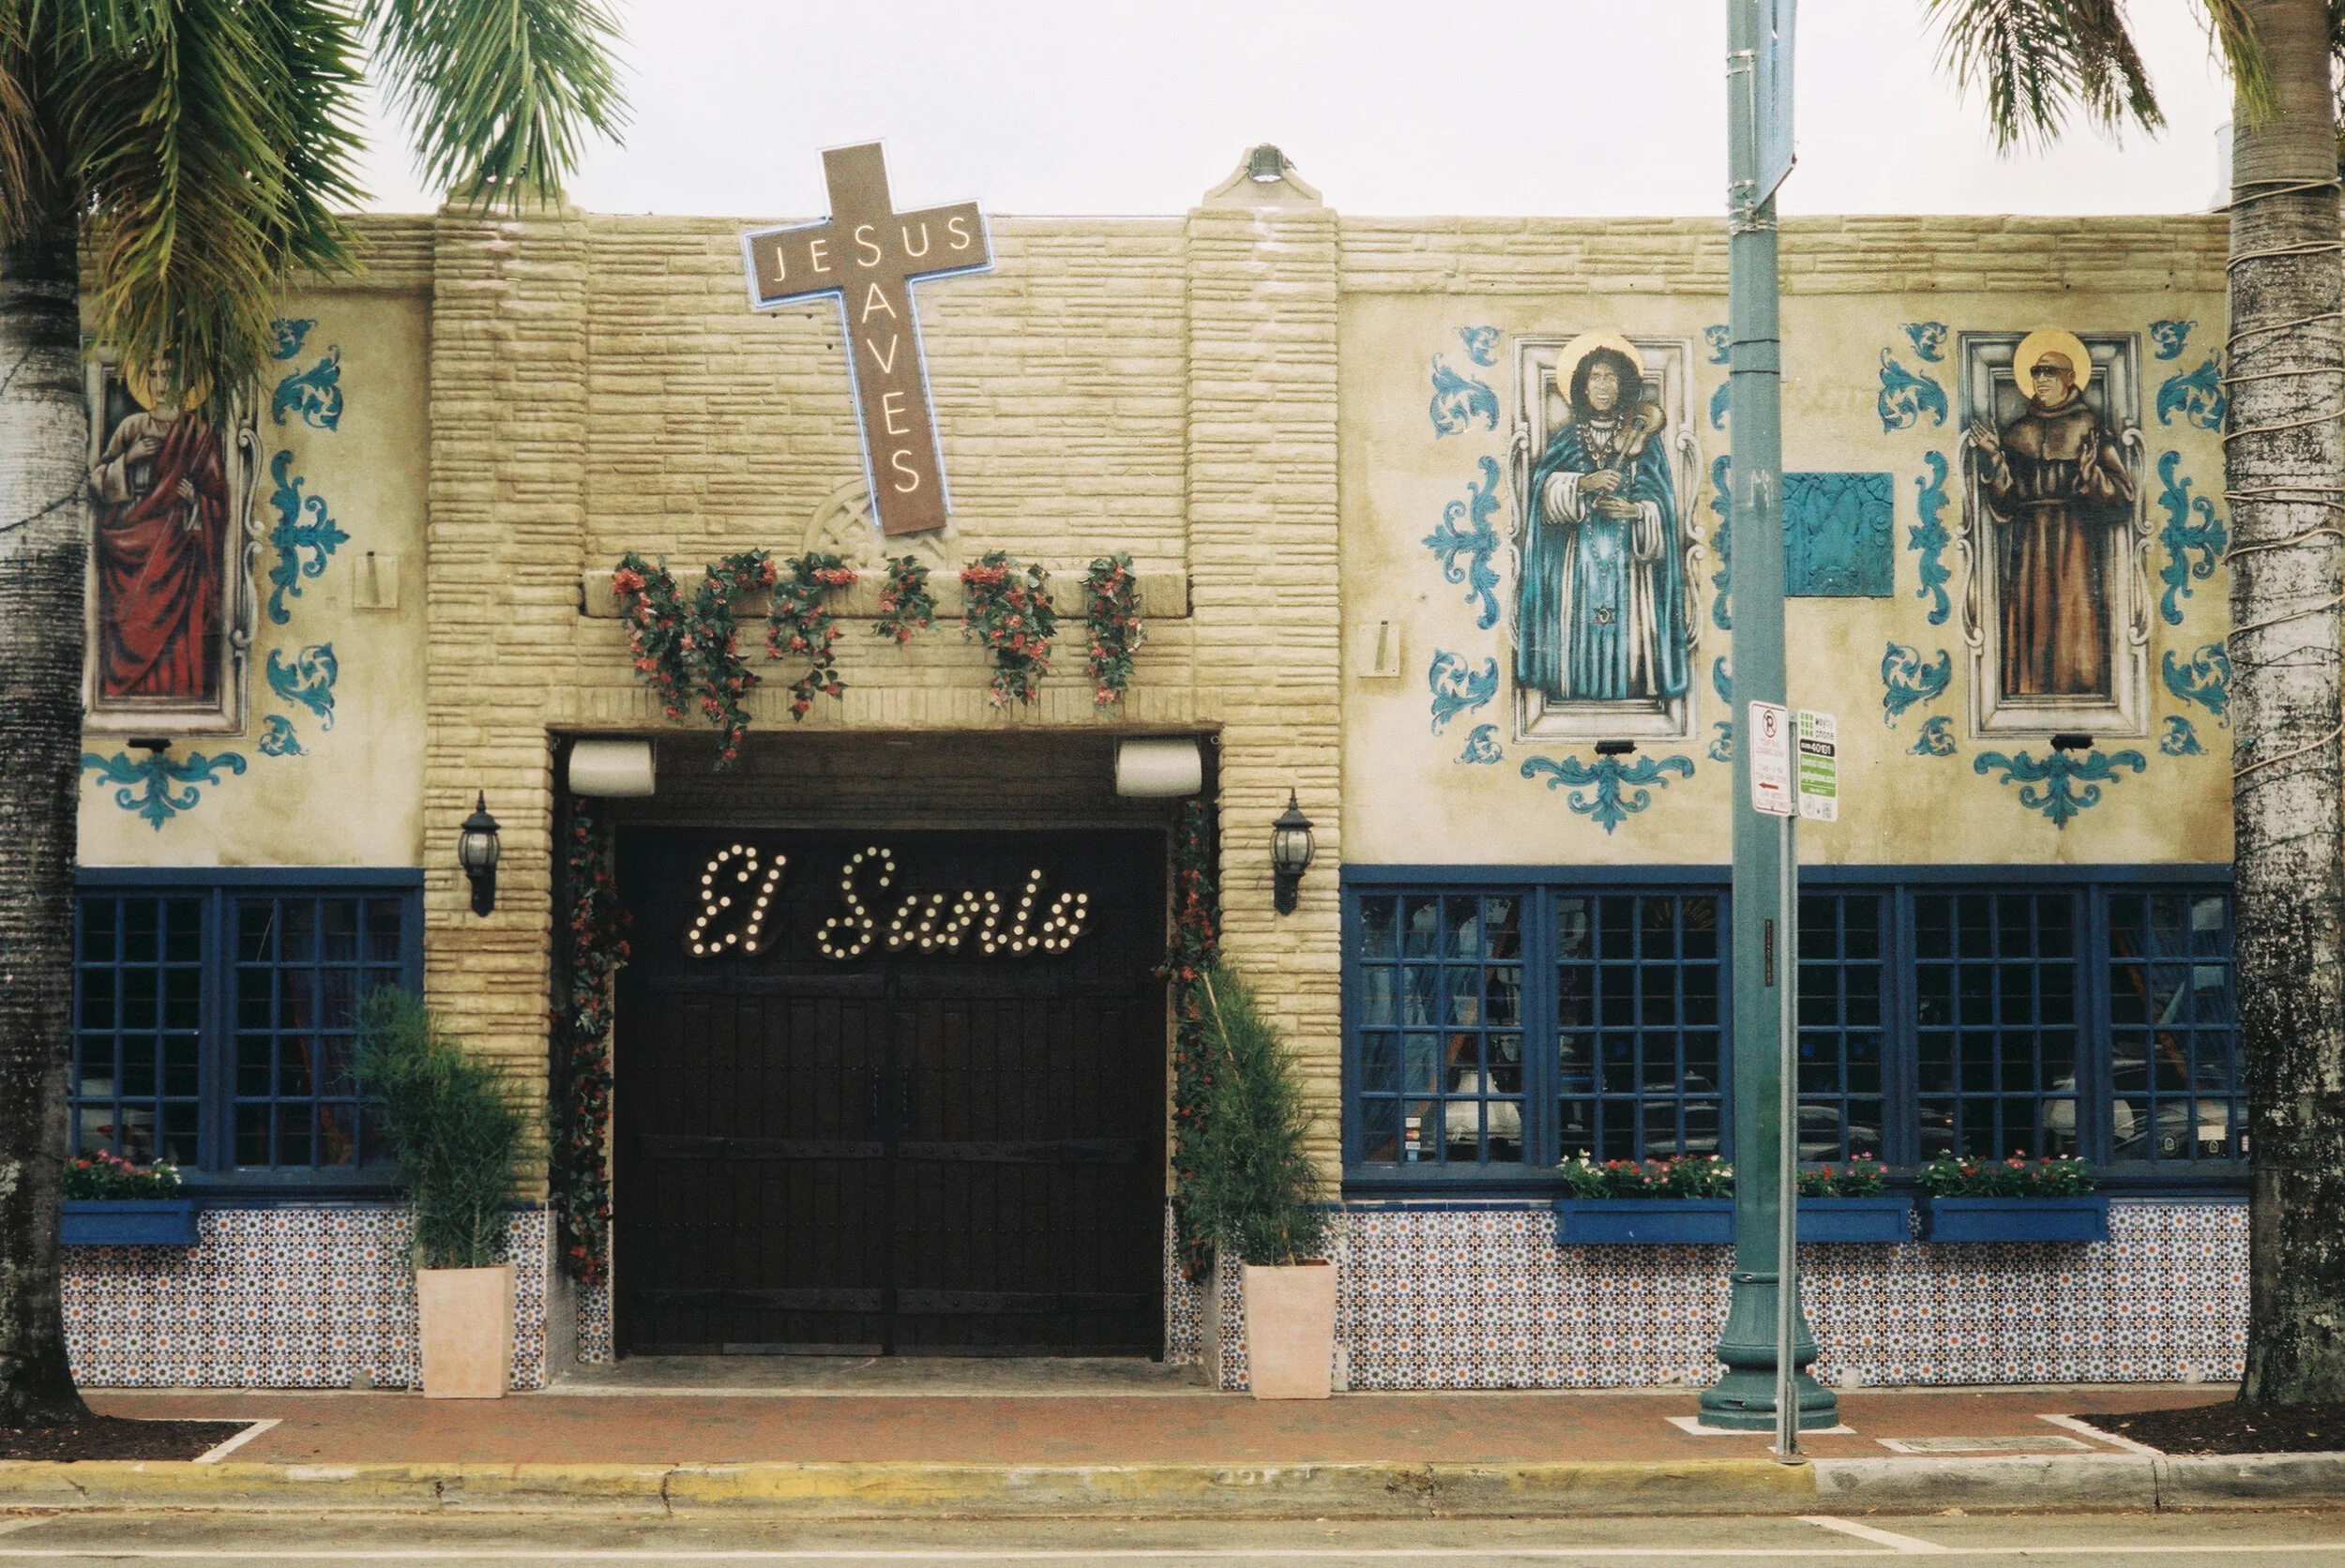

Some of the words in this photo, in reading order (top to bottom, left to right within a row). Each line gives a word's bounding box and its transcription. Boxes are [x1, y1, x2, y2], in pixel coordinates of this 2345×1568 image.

[773, 216, 971, 282] JESUS
[854, 224, 919, 493] SAVES
[1811, 743, 1831, 755] 40101
[682, 844, 788, 957] El
[815, 846, 1092, 957] Santo
